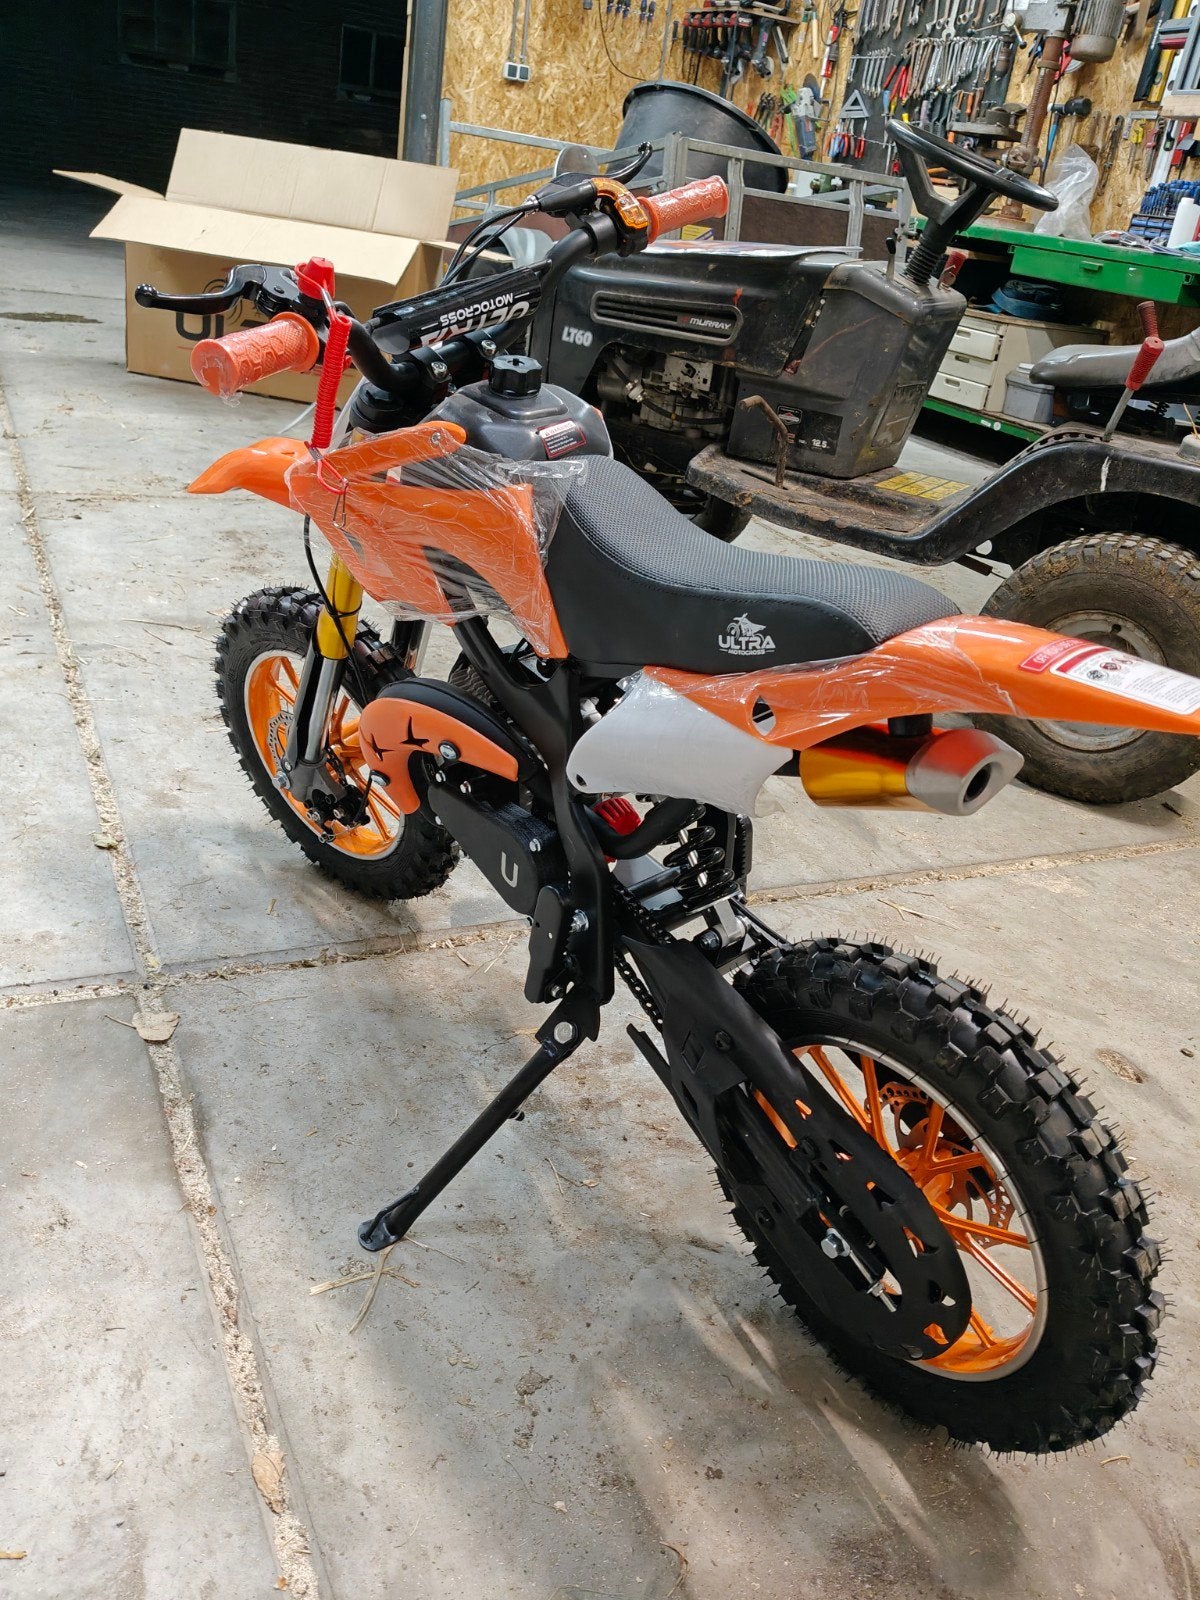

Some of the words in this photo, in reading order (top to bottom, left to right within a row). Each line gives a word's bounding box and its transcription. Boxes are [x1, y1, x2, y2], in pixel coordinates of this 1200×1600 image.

[439, 292, 514, 328] MOTOCROSS
[689, 318, 732, 329] MURRAY
[561, 325, 593, 347] LT60
[718, 634, 776, 650] ULTRA
[500, 851, 519, 888] U
